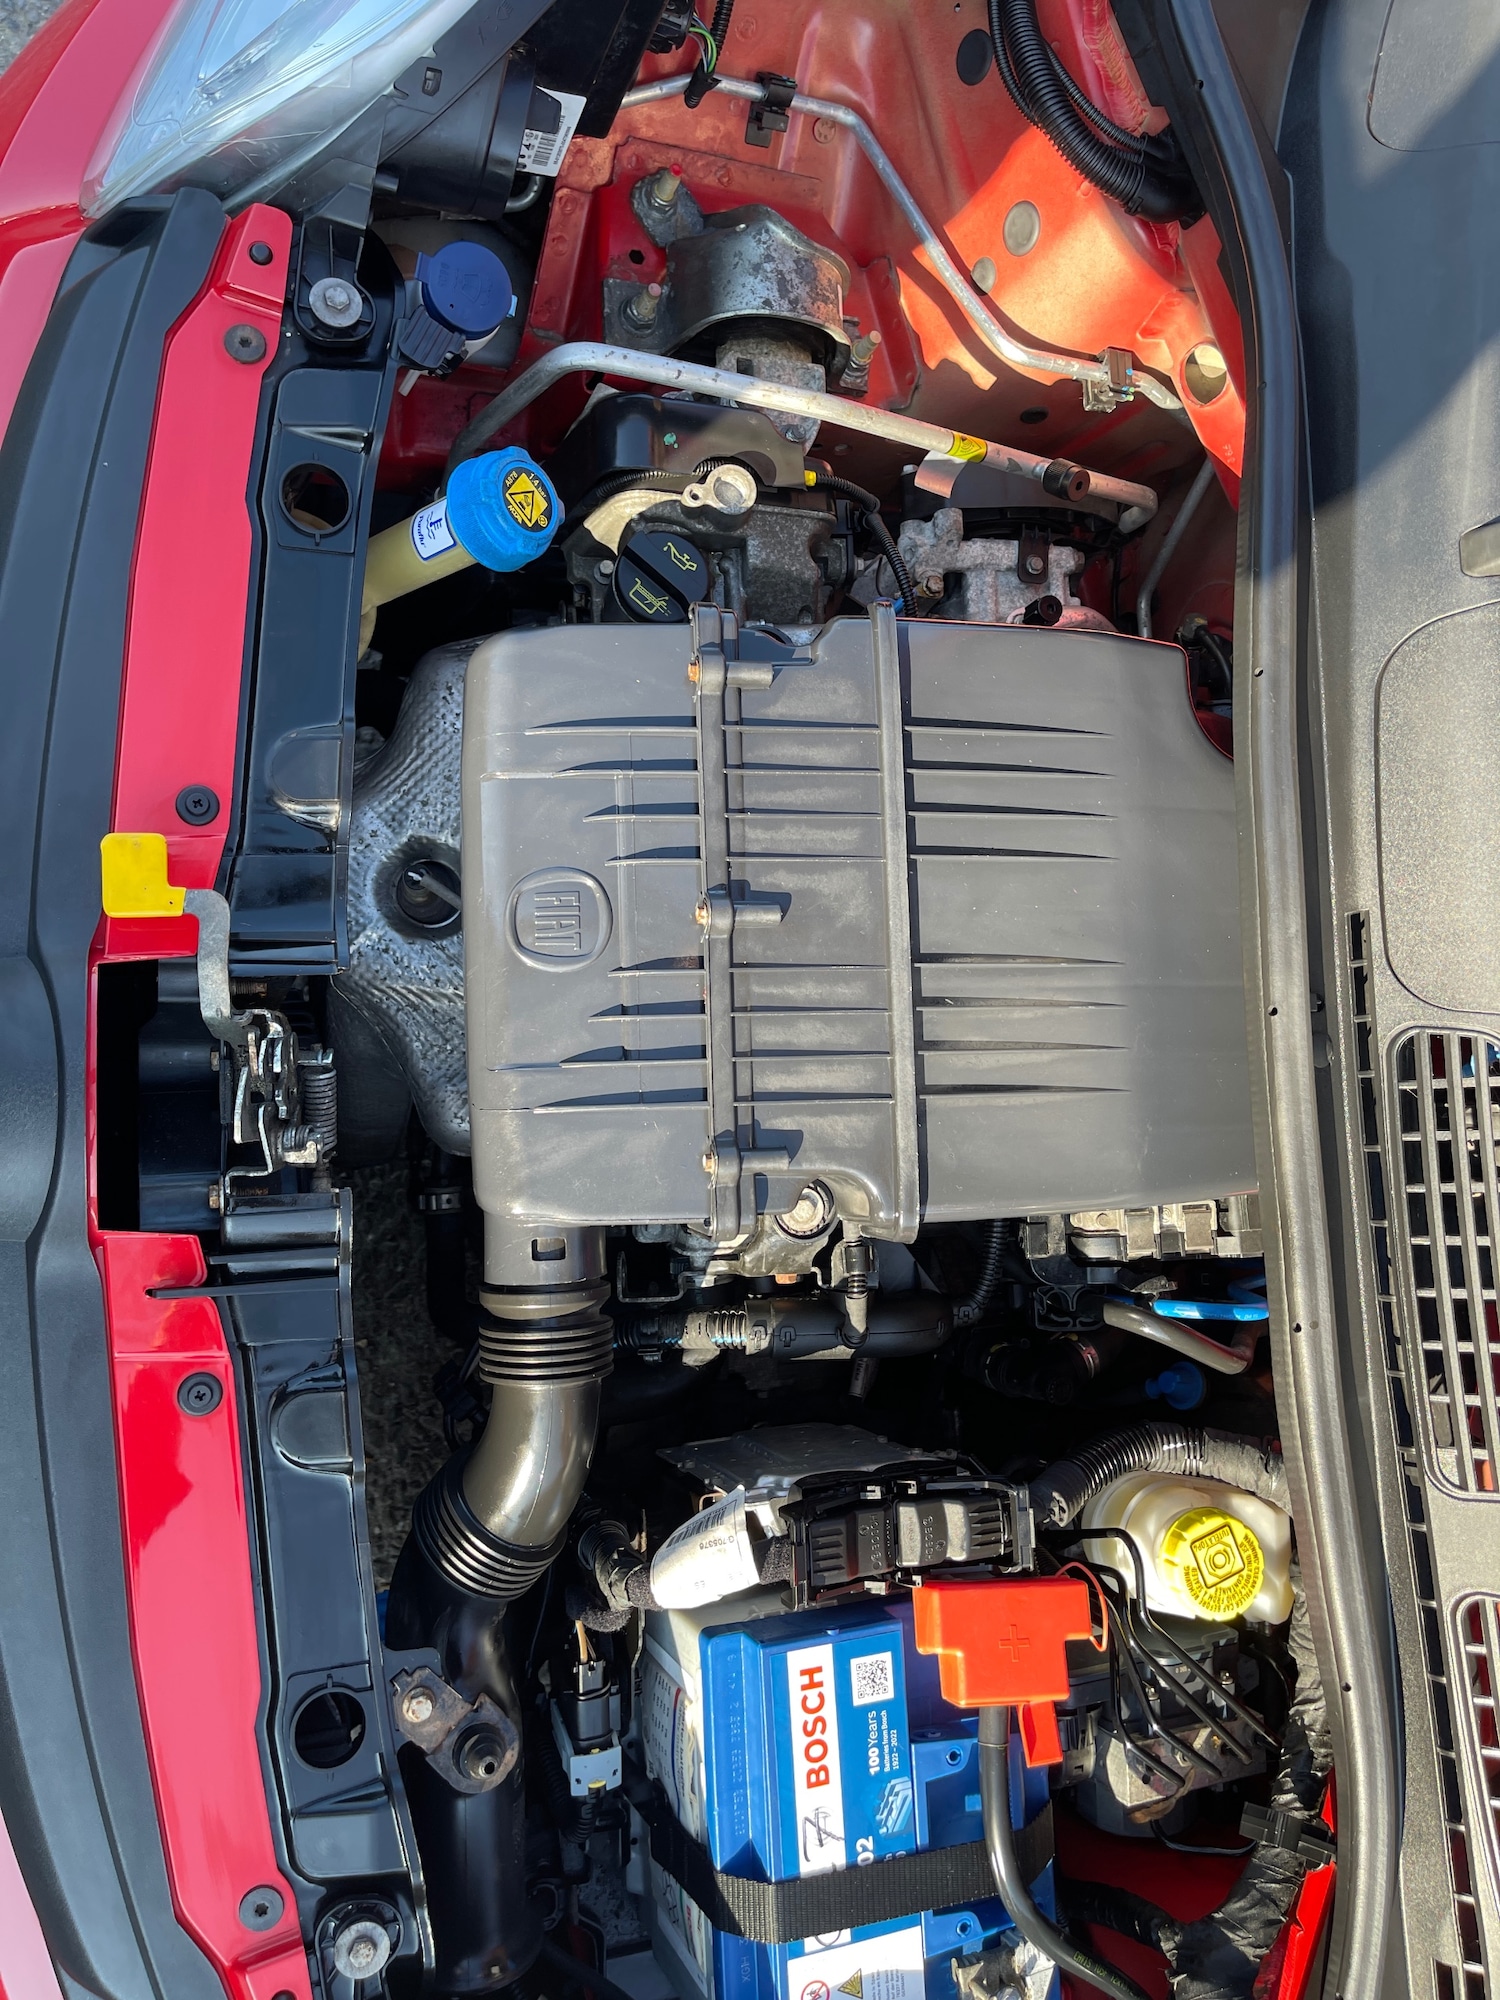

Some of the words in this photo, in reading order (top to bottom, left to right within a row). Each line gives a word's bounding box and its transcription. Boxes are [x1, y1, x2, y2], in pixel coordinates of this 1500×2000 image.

[534, 890, 581, 950] FIAT
[1193, 1539, 1209, 1552] TOP4
[1209, 1528, 1230, 1545] TUTELA
[1184, 1565, 1199, 1601] REMOVING
[1191, 1567, 1204, 1593] SEALED
[1199, 1599, 1221, 1613] BEFORE
[1223, 1603, 1235, 1612] CAP
[799, 1665, 831, 1789] BOSCH
[867, 1710, 878, 1747] Years
[880, 1709, 888, 1730] Bosch
[868, 1747, 880, 1776] 100
[883, 1744, 891, 1772] Batteries
[891, 1753, 899, 1770] 1922
